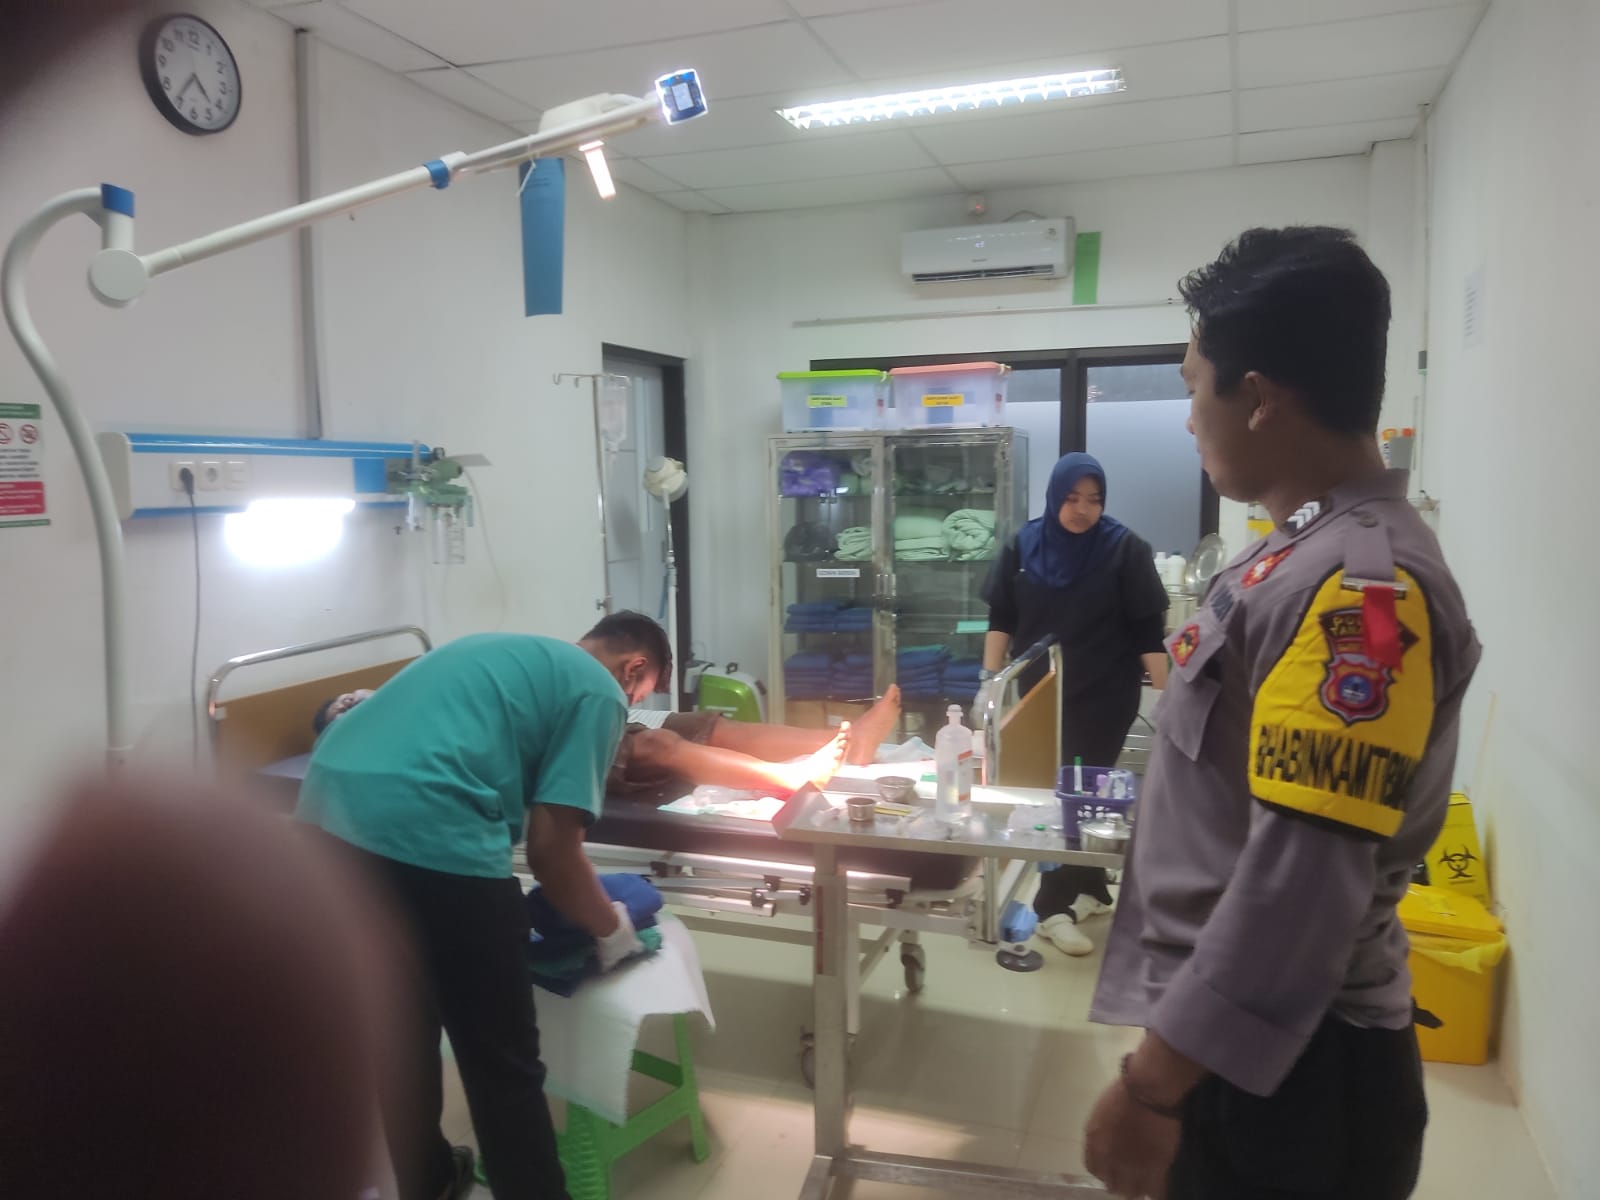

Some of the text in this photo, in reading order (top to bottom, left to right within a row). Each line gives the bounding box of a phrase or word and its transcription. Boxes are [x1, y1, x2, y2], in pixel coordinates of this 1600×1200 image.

[188, 30, 200, 45] 12
[216, 60, 223, 74] 2
[190, 107, 198, 121] 6
